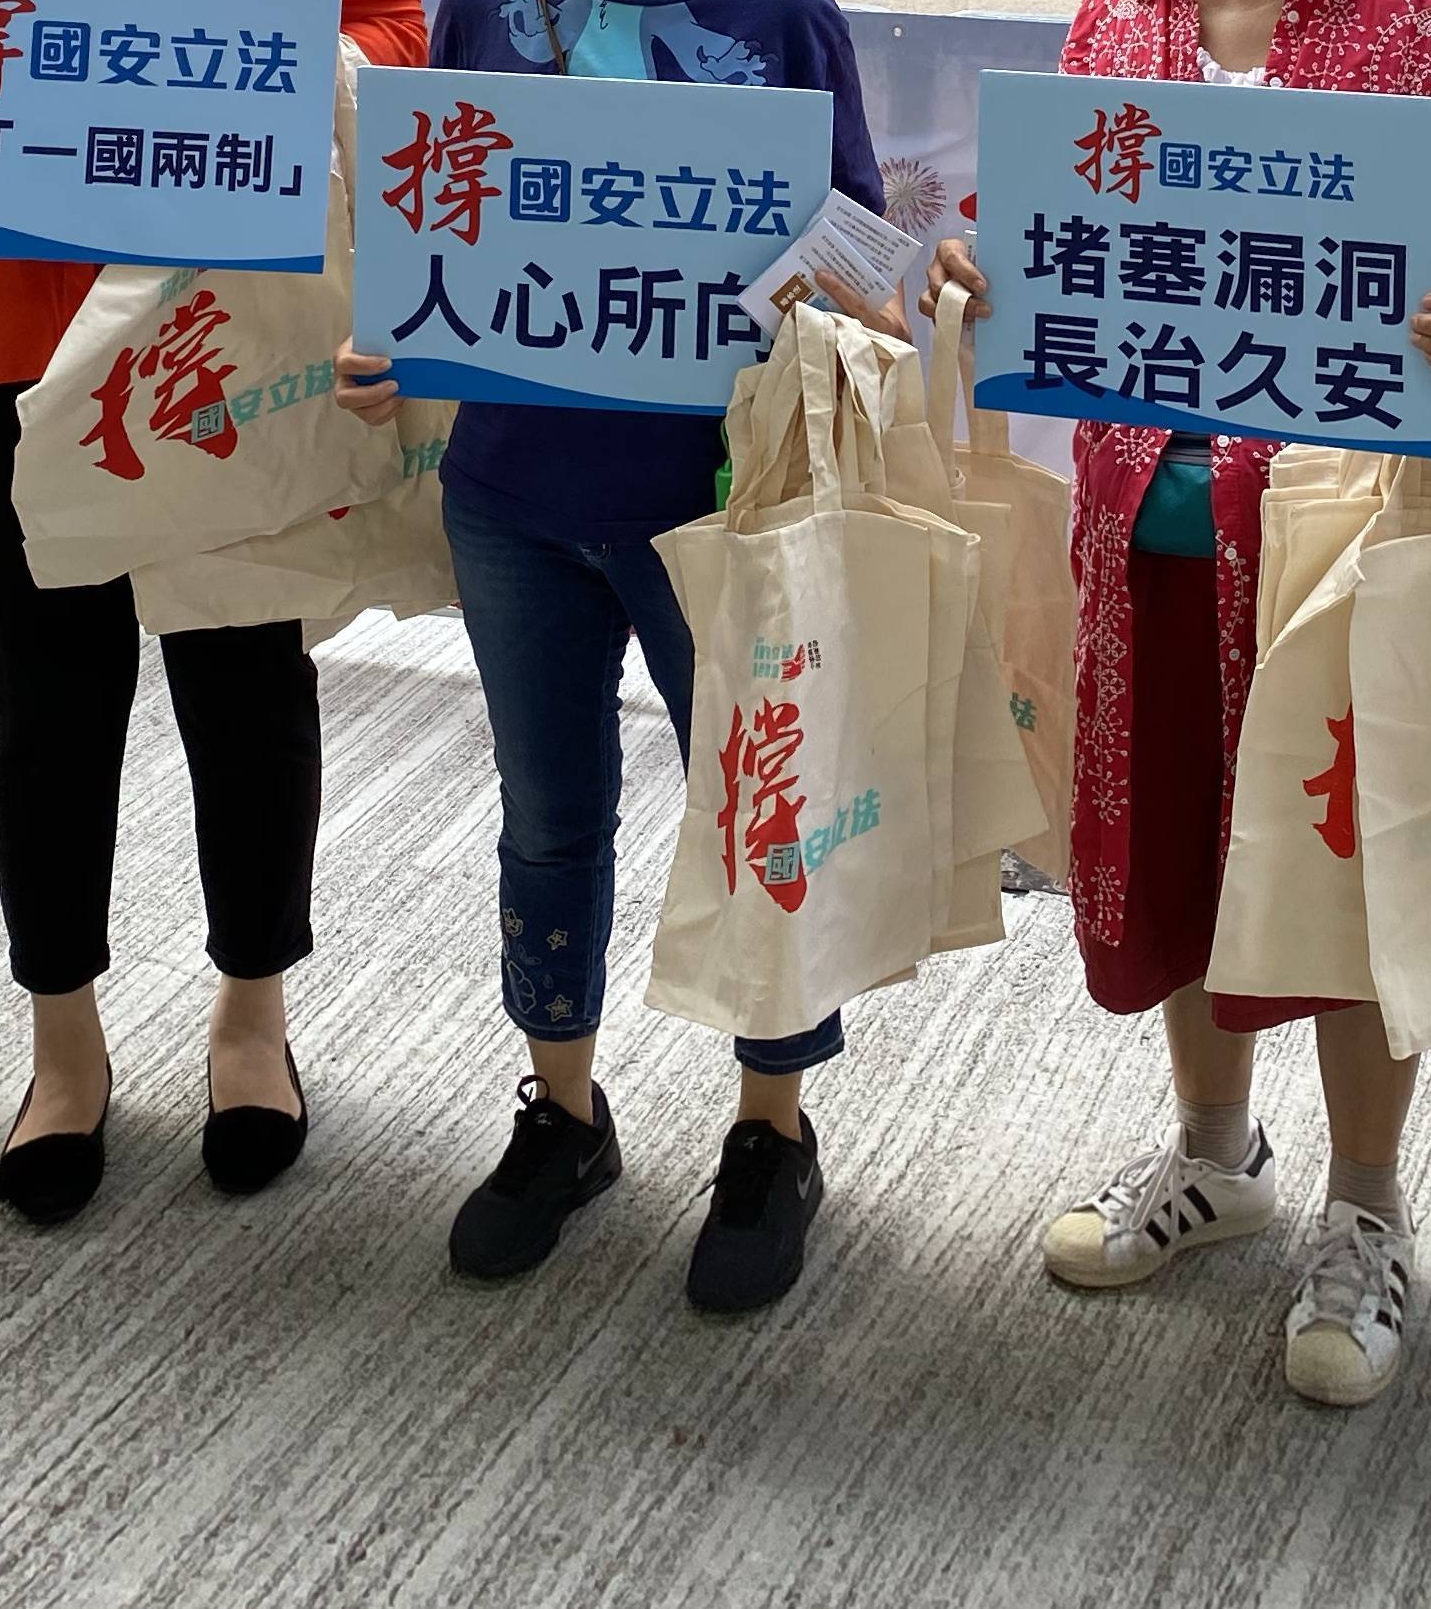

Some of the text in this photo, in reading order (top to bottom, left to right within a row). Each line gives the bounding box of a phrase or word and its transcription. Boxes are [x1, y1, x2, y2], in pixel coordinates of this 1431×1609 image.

[381, 102, 792, 246] 撐國安立法
[1073, 102, 1356, 205] 撐國安立法
[390, 253, 773, 363] 人心所向
[1022, 211, 1409, 329] 堵塞漏洞
[1022, 312, 1406, 430] 長治久安
